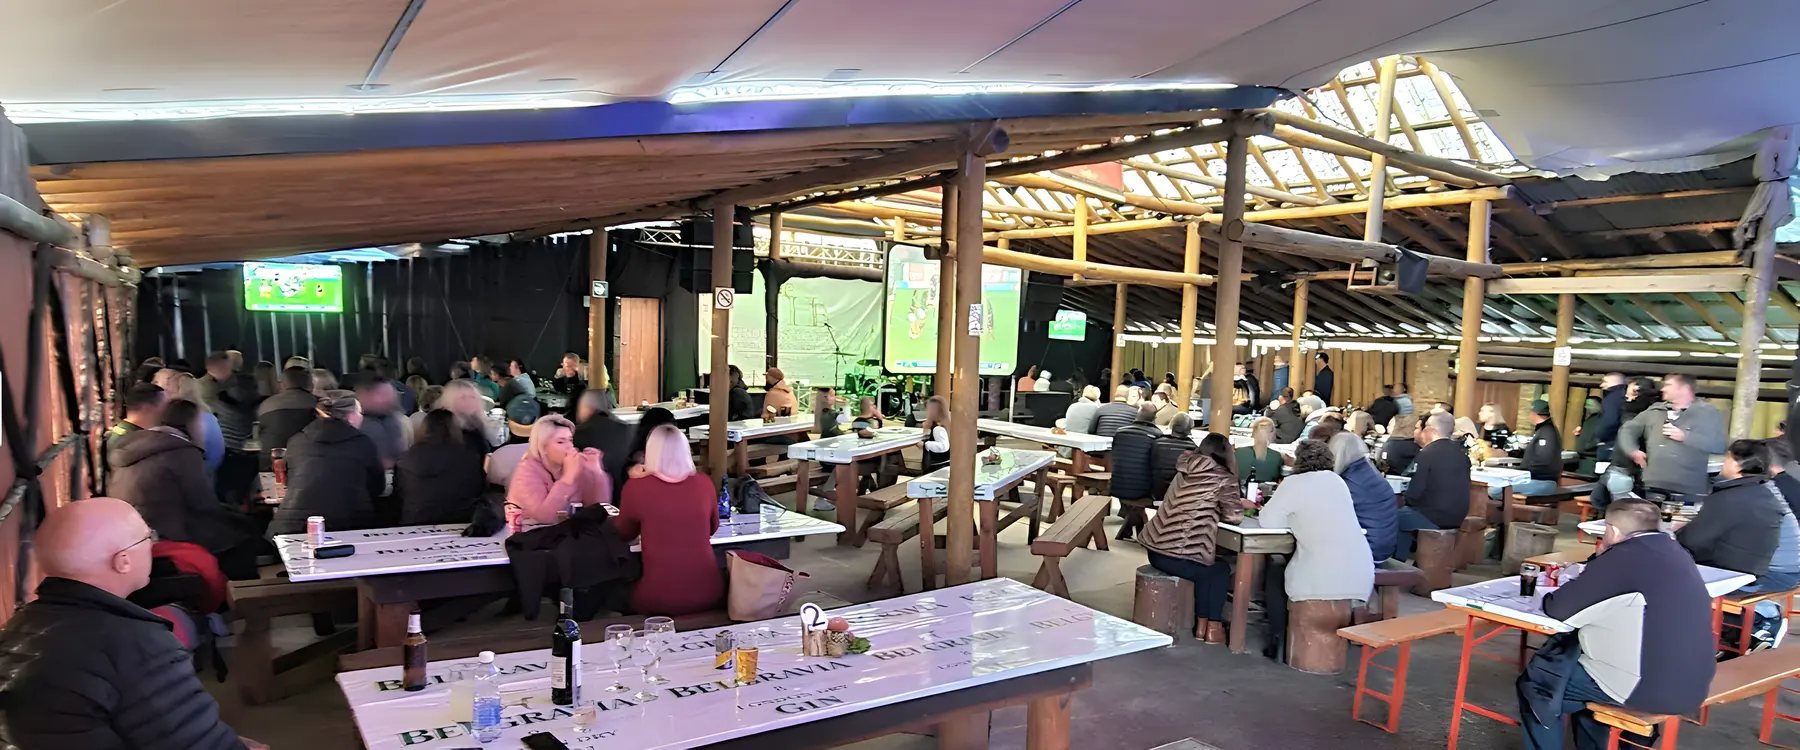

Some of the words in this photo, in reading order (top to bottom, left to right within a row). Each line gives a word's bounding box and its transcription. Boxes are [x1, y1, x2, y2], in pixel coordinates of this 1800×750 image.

[803, 605, 826, 627] 2
[666, 661, 854, 698] BELRAVIA
[775, 695, 845, 714] GIN
